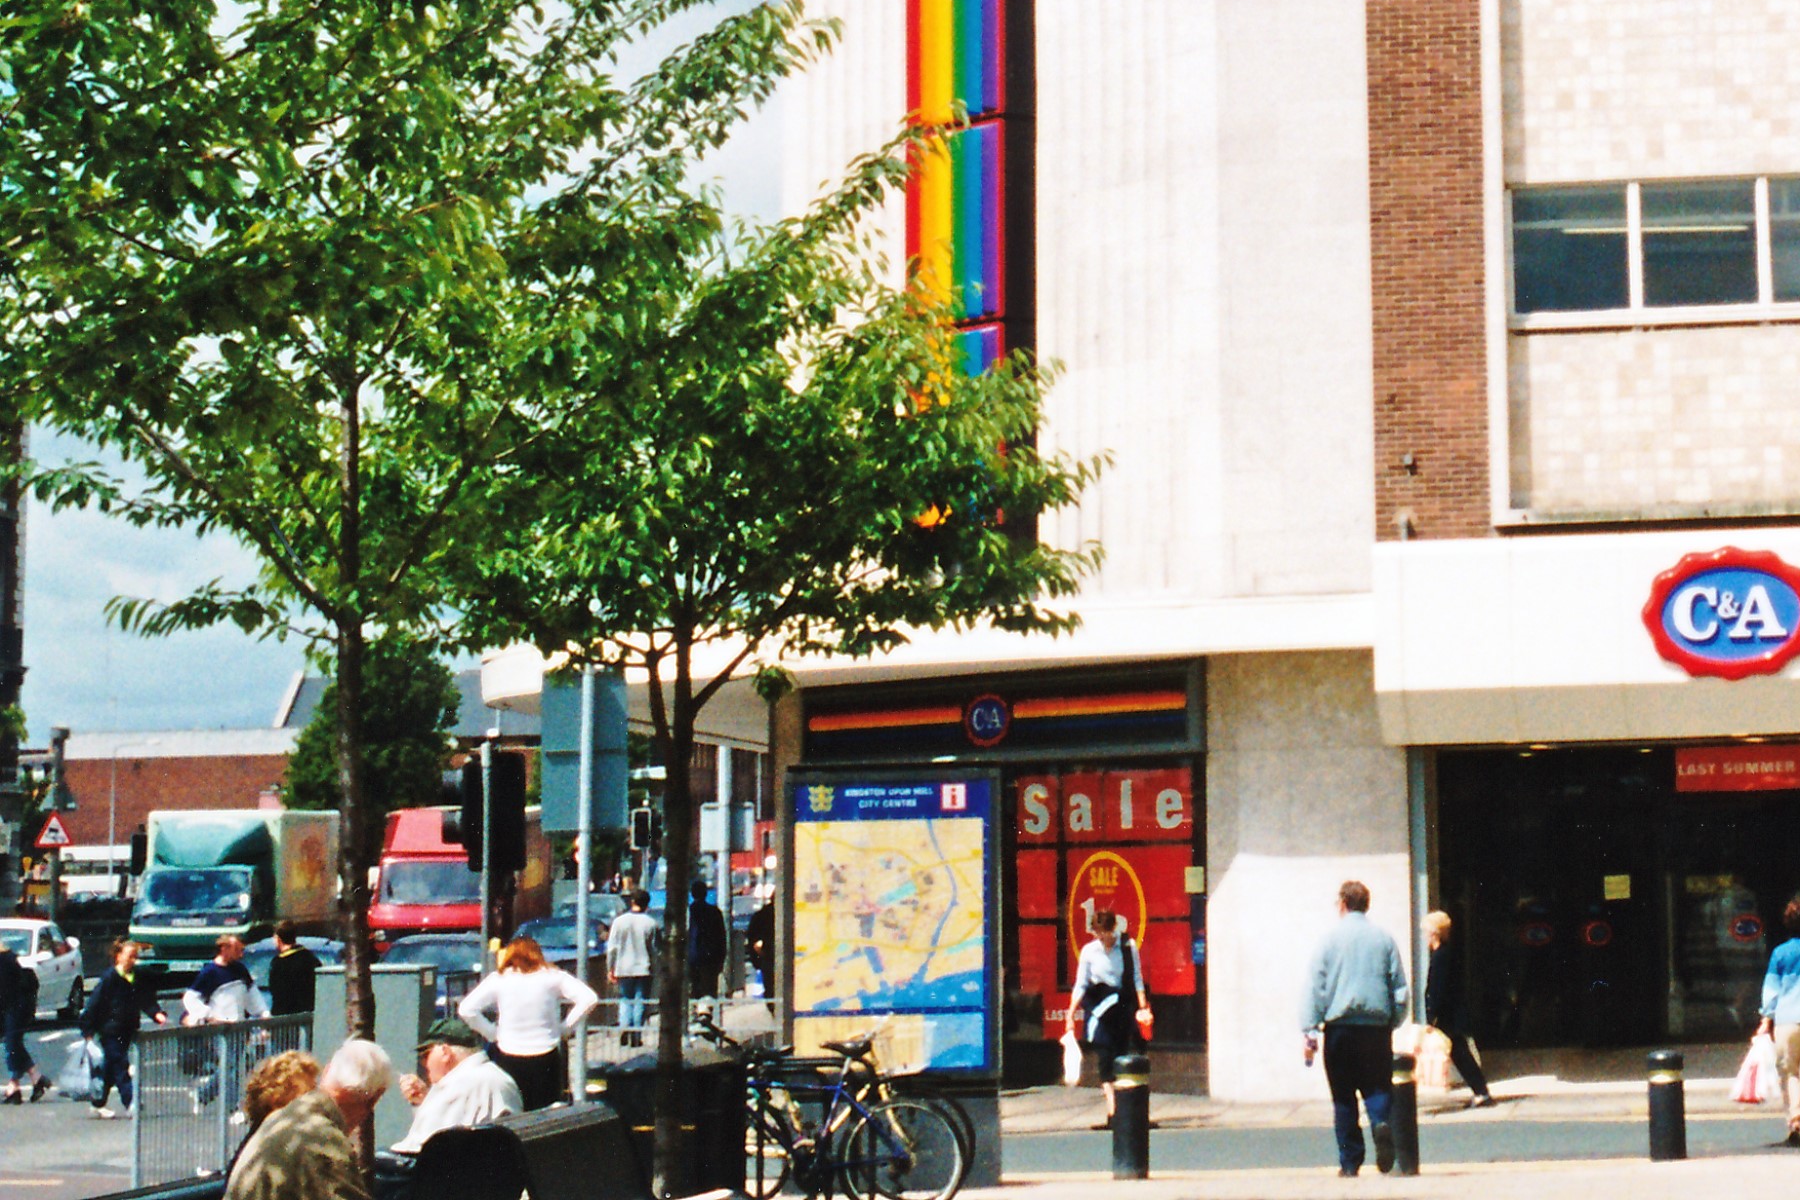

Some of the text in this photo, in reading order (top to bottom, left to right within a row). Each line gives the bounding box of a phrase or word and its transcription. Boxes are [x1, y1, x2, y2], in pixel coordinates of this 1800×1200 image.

[1673, 584, 1788, 642] C&A
[1677, 762, 1716, 776] LAST
[1722, 759, 1796, 775] SUMMER
[858, 798, 918, 809] CITY CENTRE
[1023, 778, 1184, 835] Sale
[1089, 866, 1119, 888] SALE
